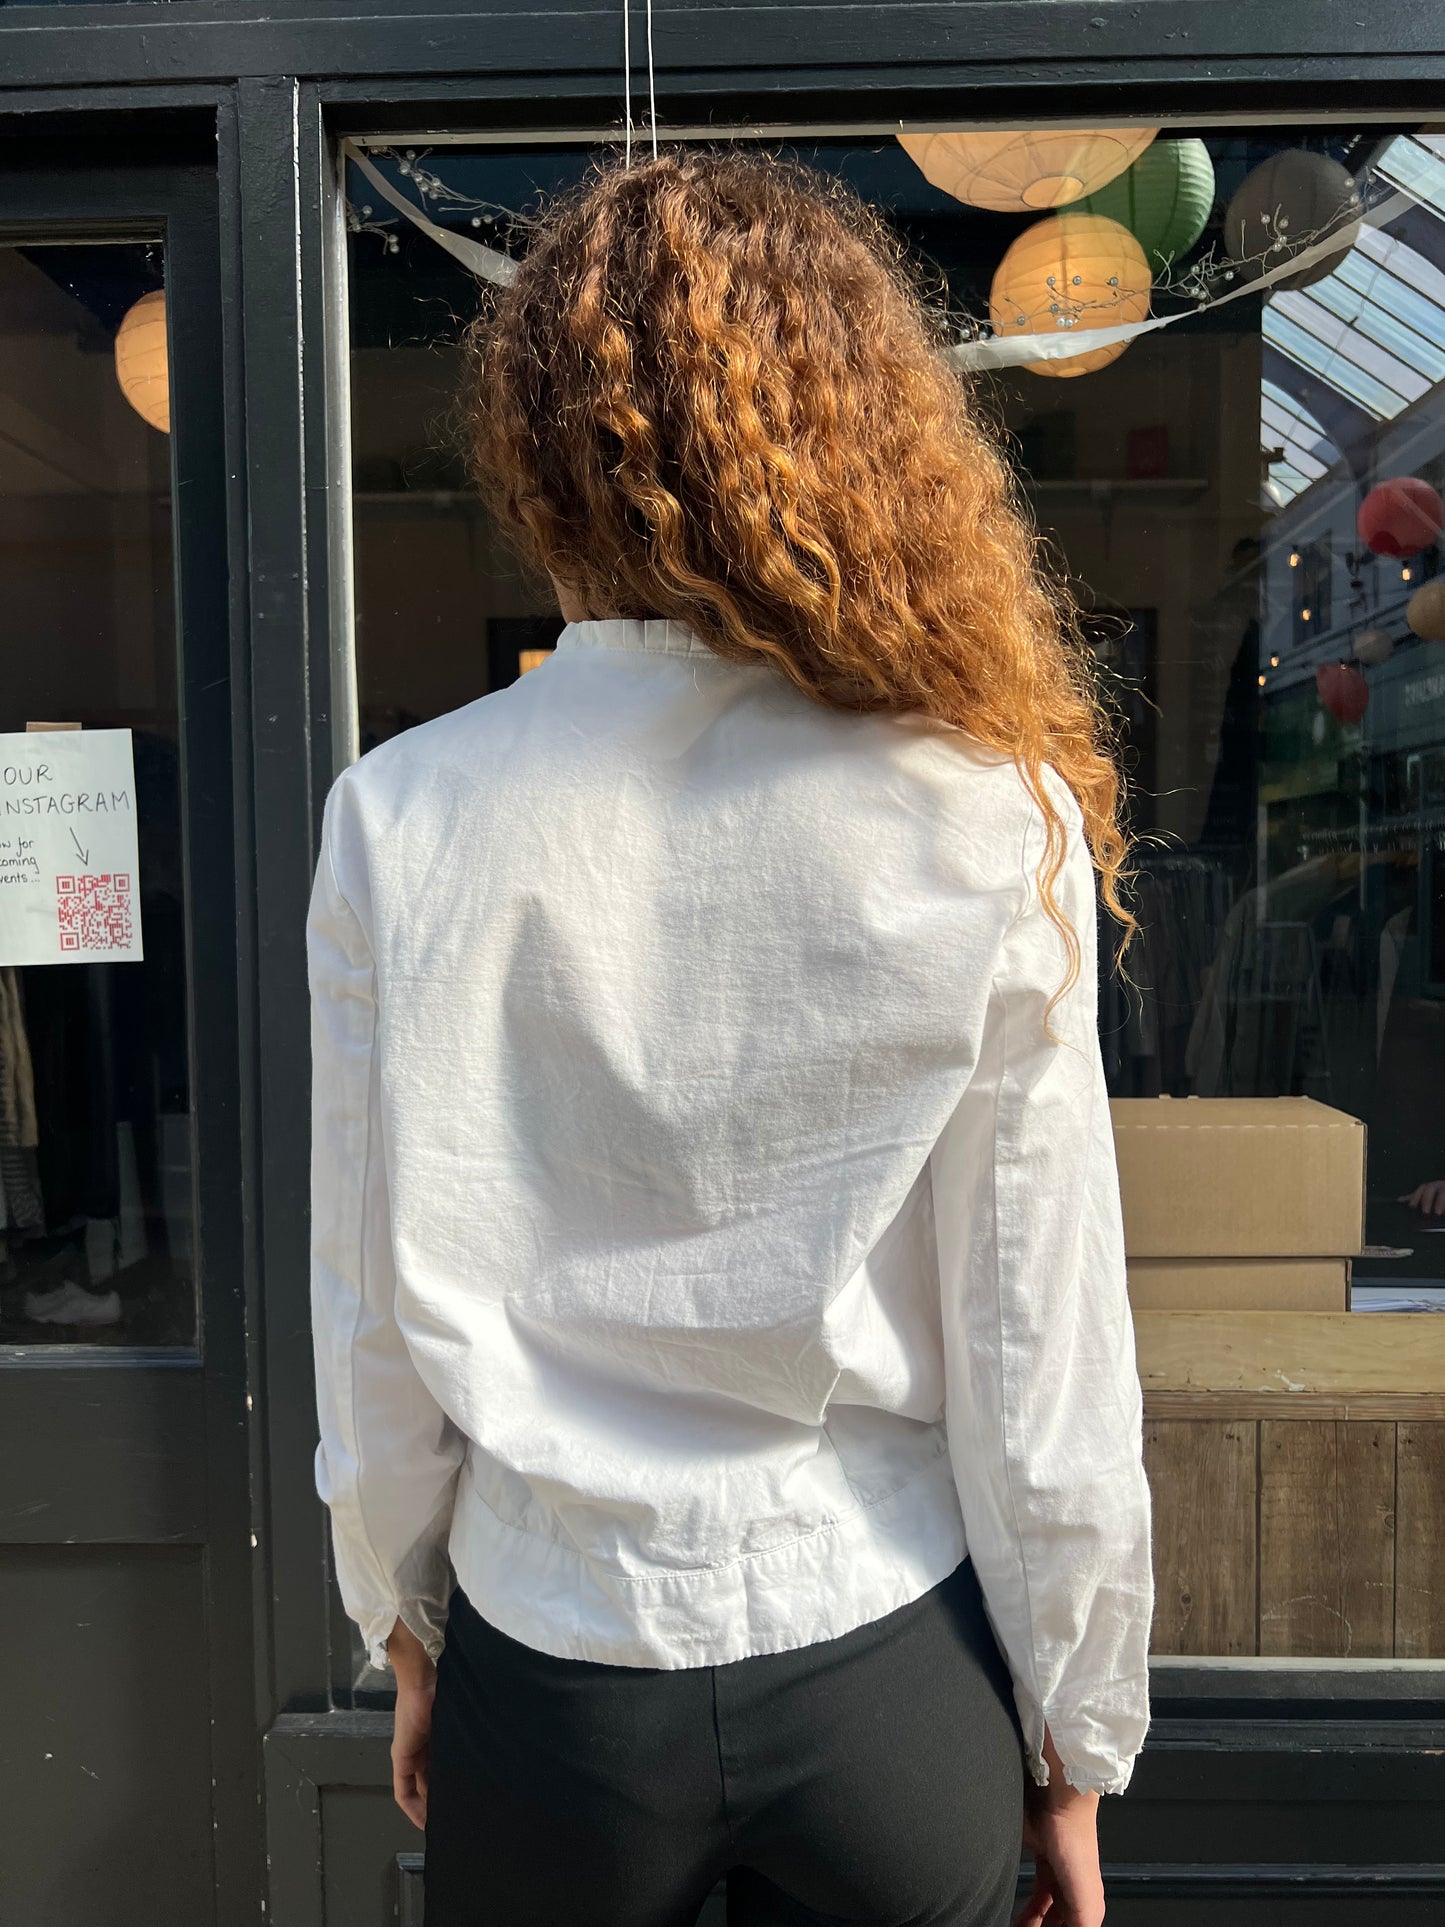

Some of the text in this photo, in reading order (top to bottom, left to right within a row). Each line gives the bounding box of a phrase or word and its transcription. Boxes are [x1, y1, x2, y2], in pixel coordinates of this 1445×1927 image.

[3, 764, 53, 786] OUR
[0, 790, 130, 817] NSTAGRAM
[16, 836, 35, 858] for
